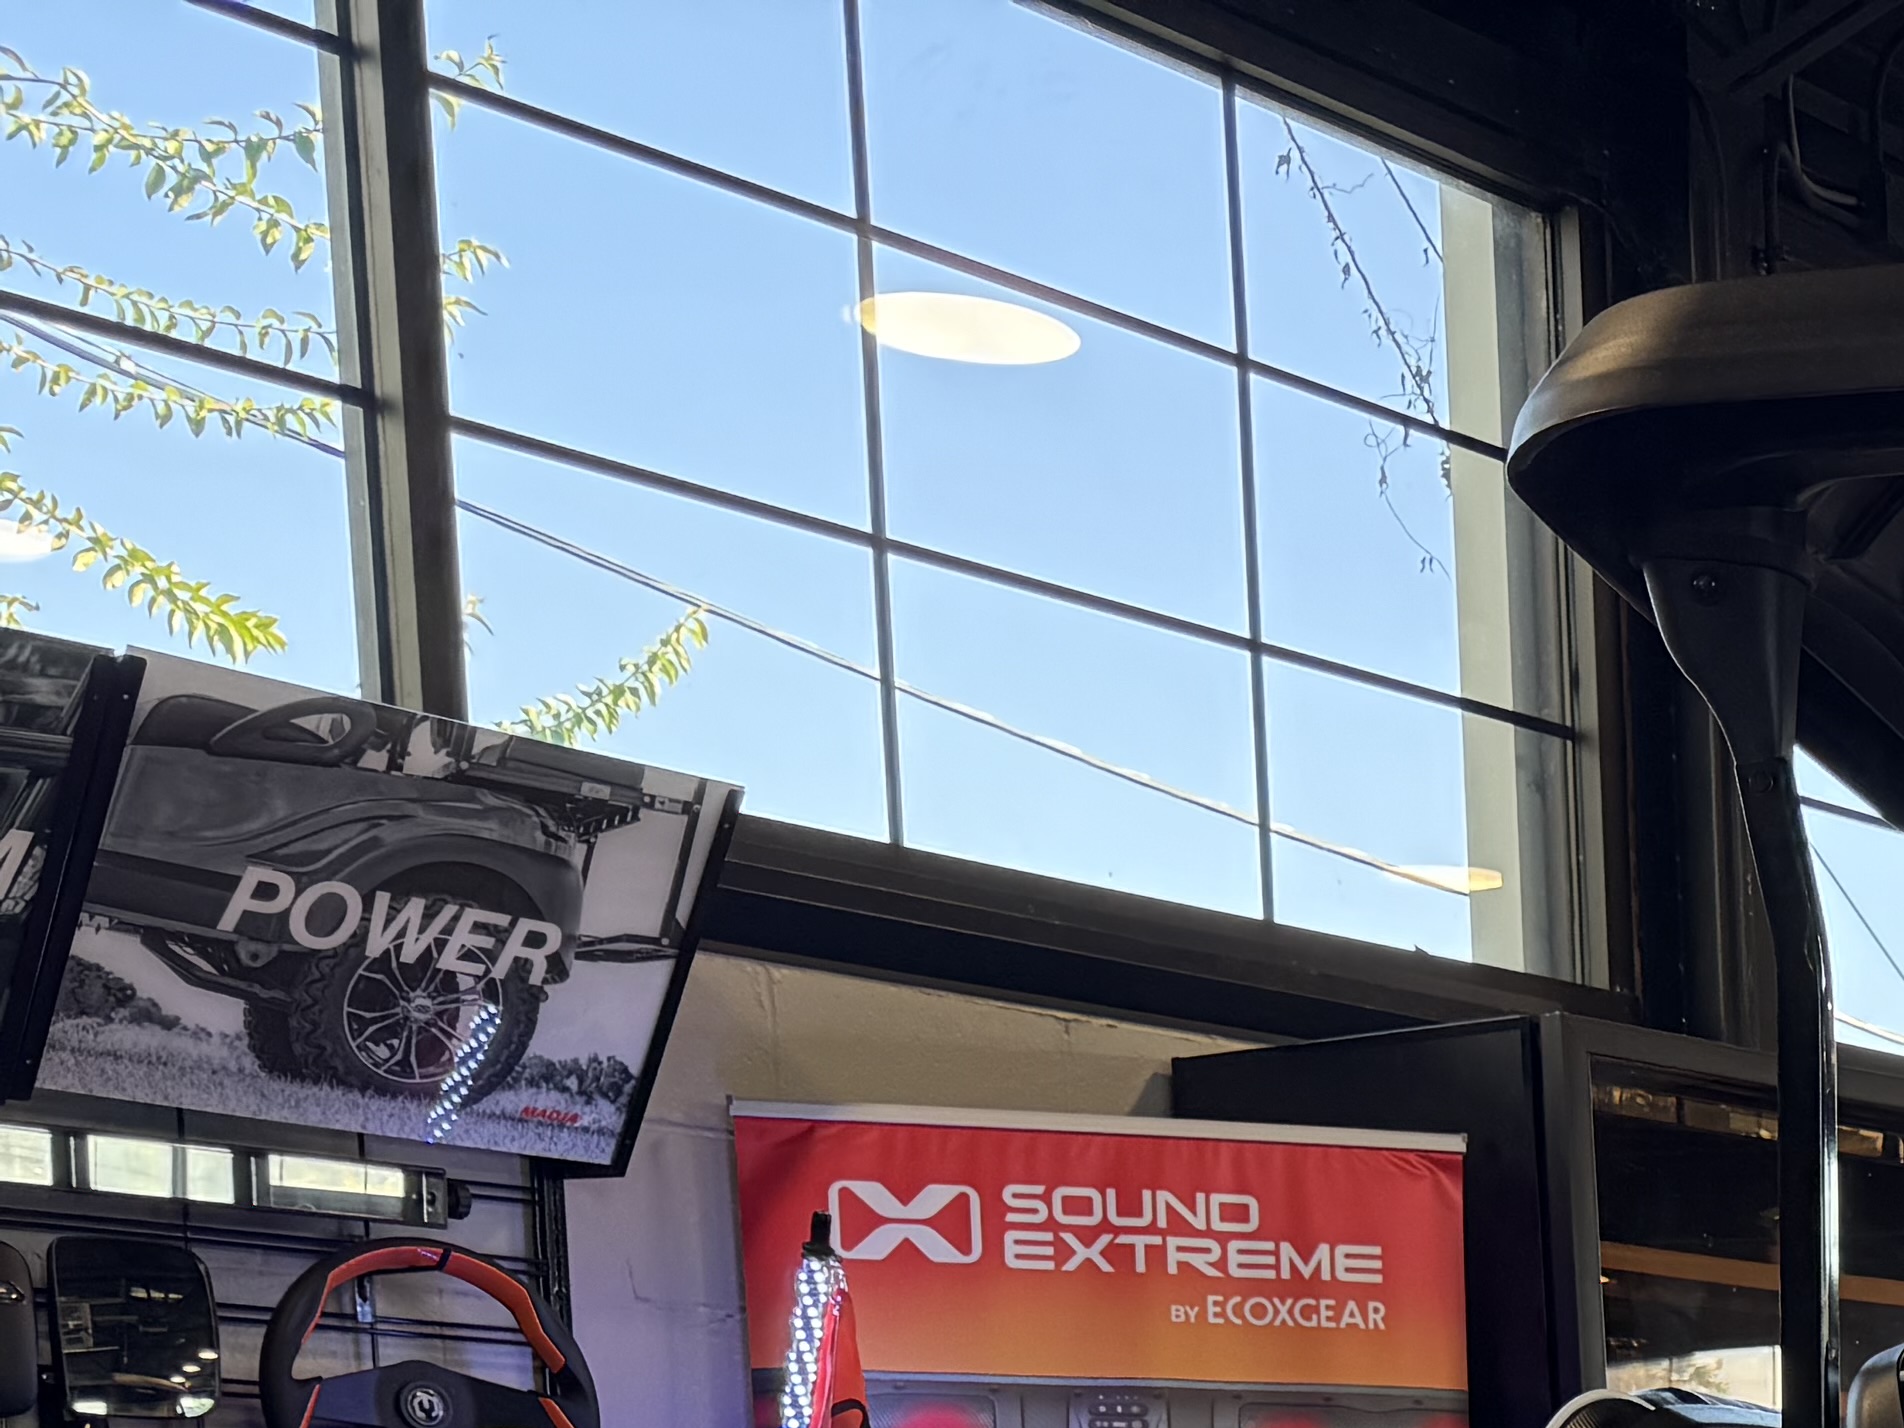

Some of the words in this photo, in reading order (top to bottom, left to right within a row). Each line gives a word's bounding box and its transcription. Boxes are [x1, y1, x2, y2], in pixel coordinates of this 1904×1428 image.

[216, 866, 562, 986] POWER
[1002, 1184, 1259, 1233] SOUND
[1004, 1230, 1383, 1284] EXTREME
[1171, 1305, 1199, 1323] BY
[1207, 1295, 1386, 1330] ECOXGEAR
